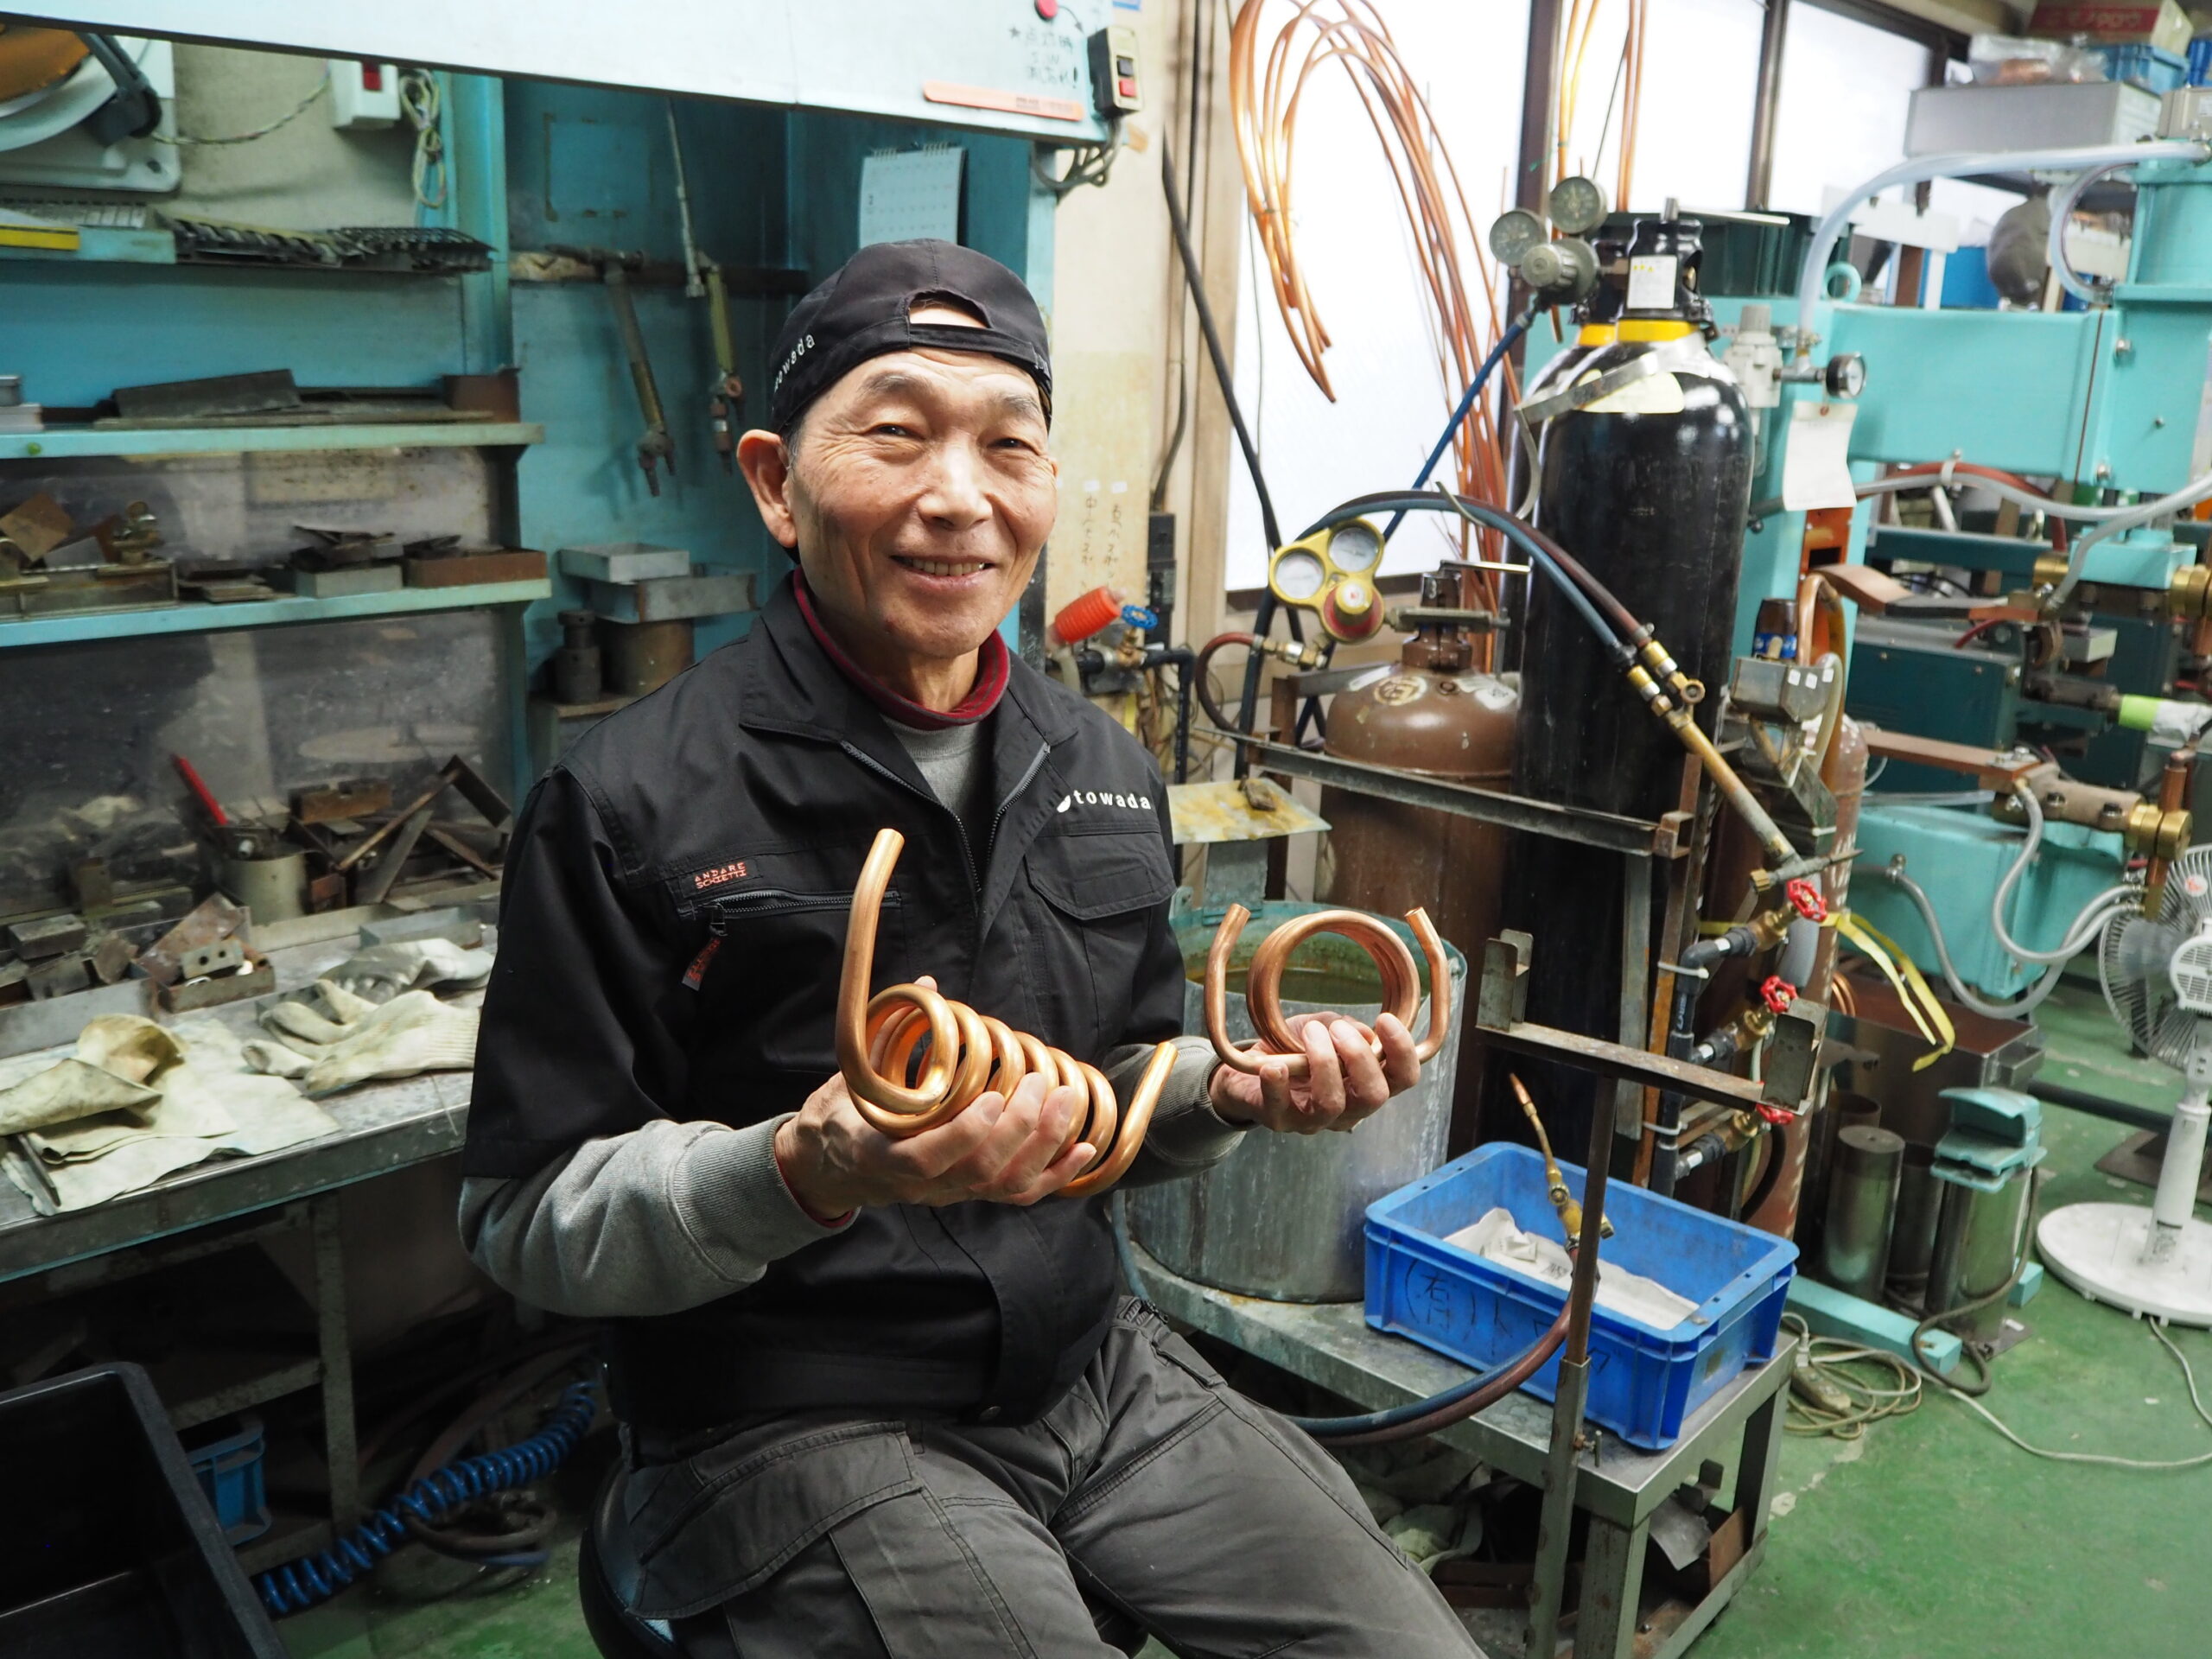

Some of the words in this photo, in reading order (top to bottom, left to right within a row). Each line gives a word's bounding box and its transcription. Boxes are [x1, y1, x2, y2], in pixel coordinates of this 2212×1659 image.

[1073, 789, 1152, 810] towada
[695, 862, 746, 882] ANDARE
[696, 869, 747, 890] SCHIETTI
